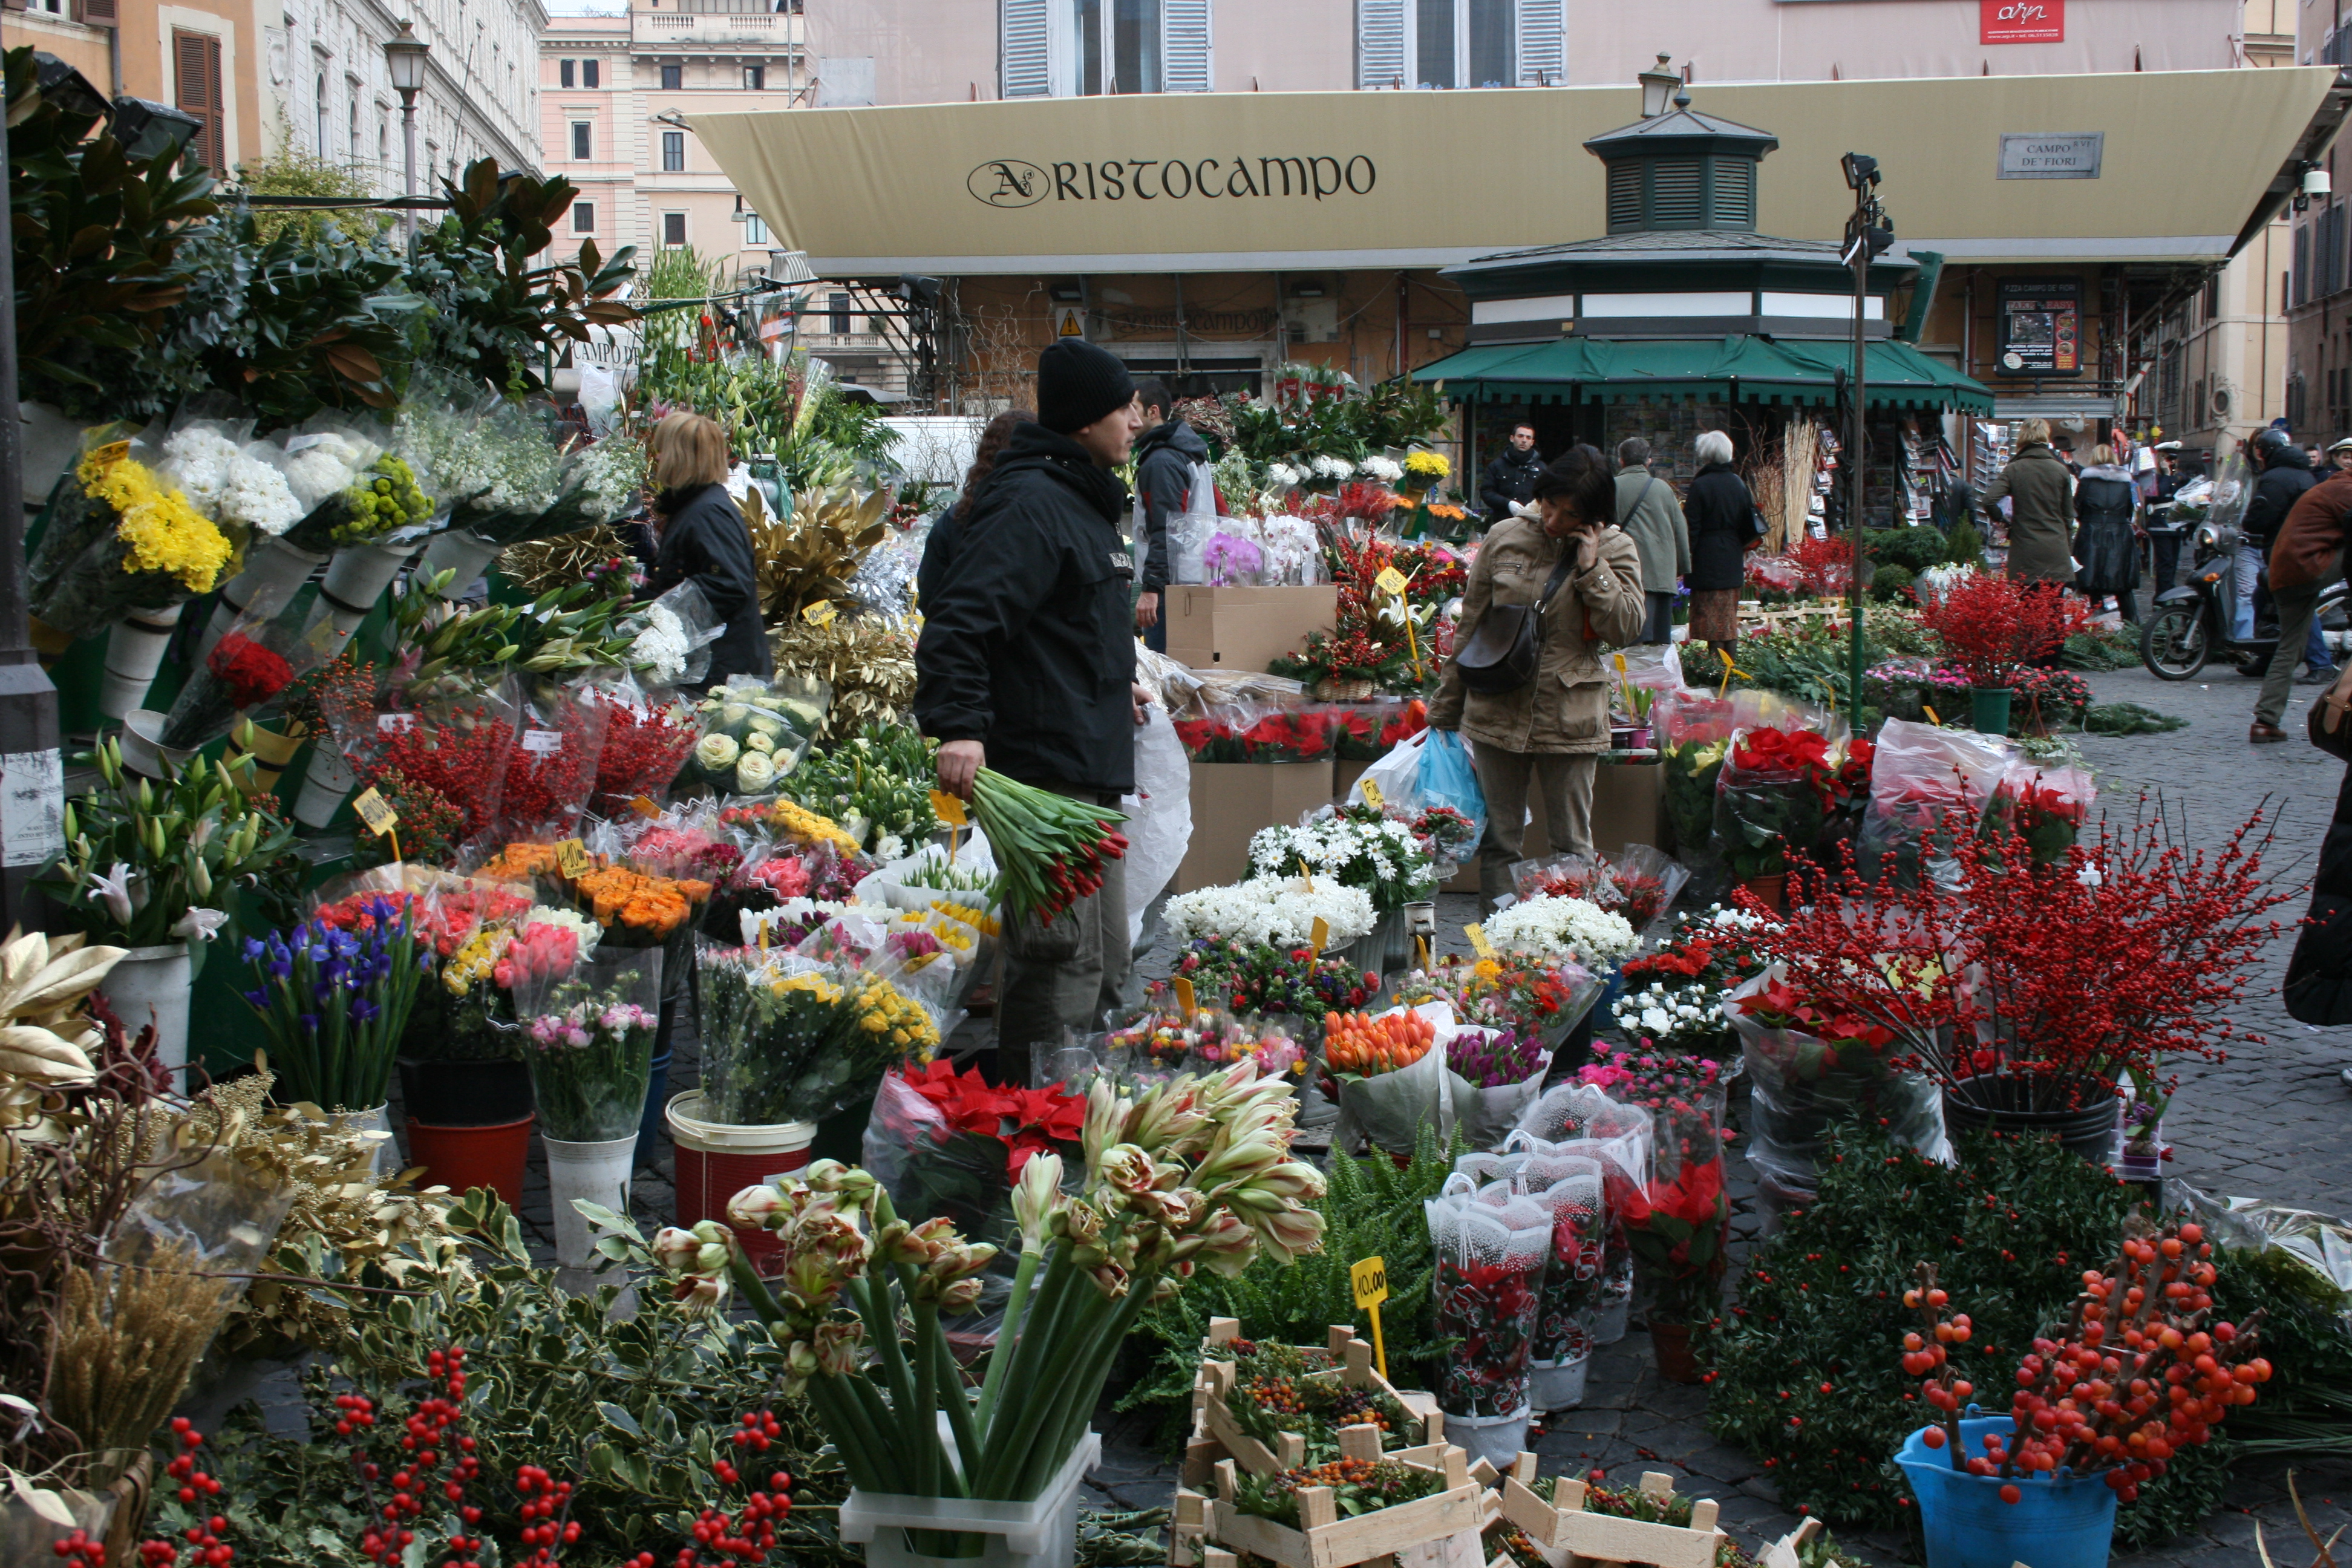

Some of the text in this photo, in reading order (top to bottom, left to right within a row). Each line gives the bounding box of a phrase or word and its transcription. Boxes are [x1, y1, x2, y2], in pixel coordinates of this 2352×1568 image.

[2027, 145, 2071, 154] CAMPO
[2044, 157, 2077, 166] FIORI
[2046, 301, 2074, 309] EASY
[572, 339, 621, 364] CAMPO
